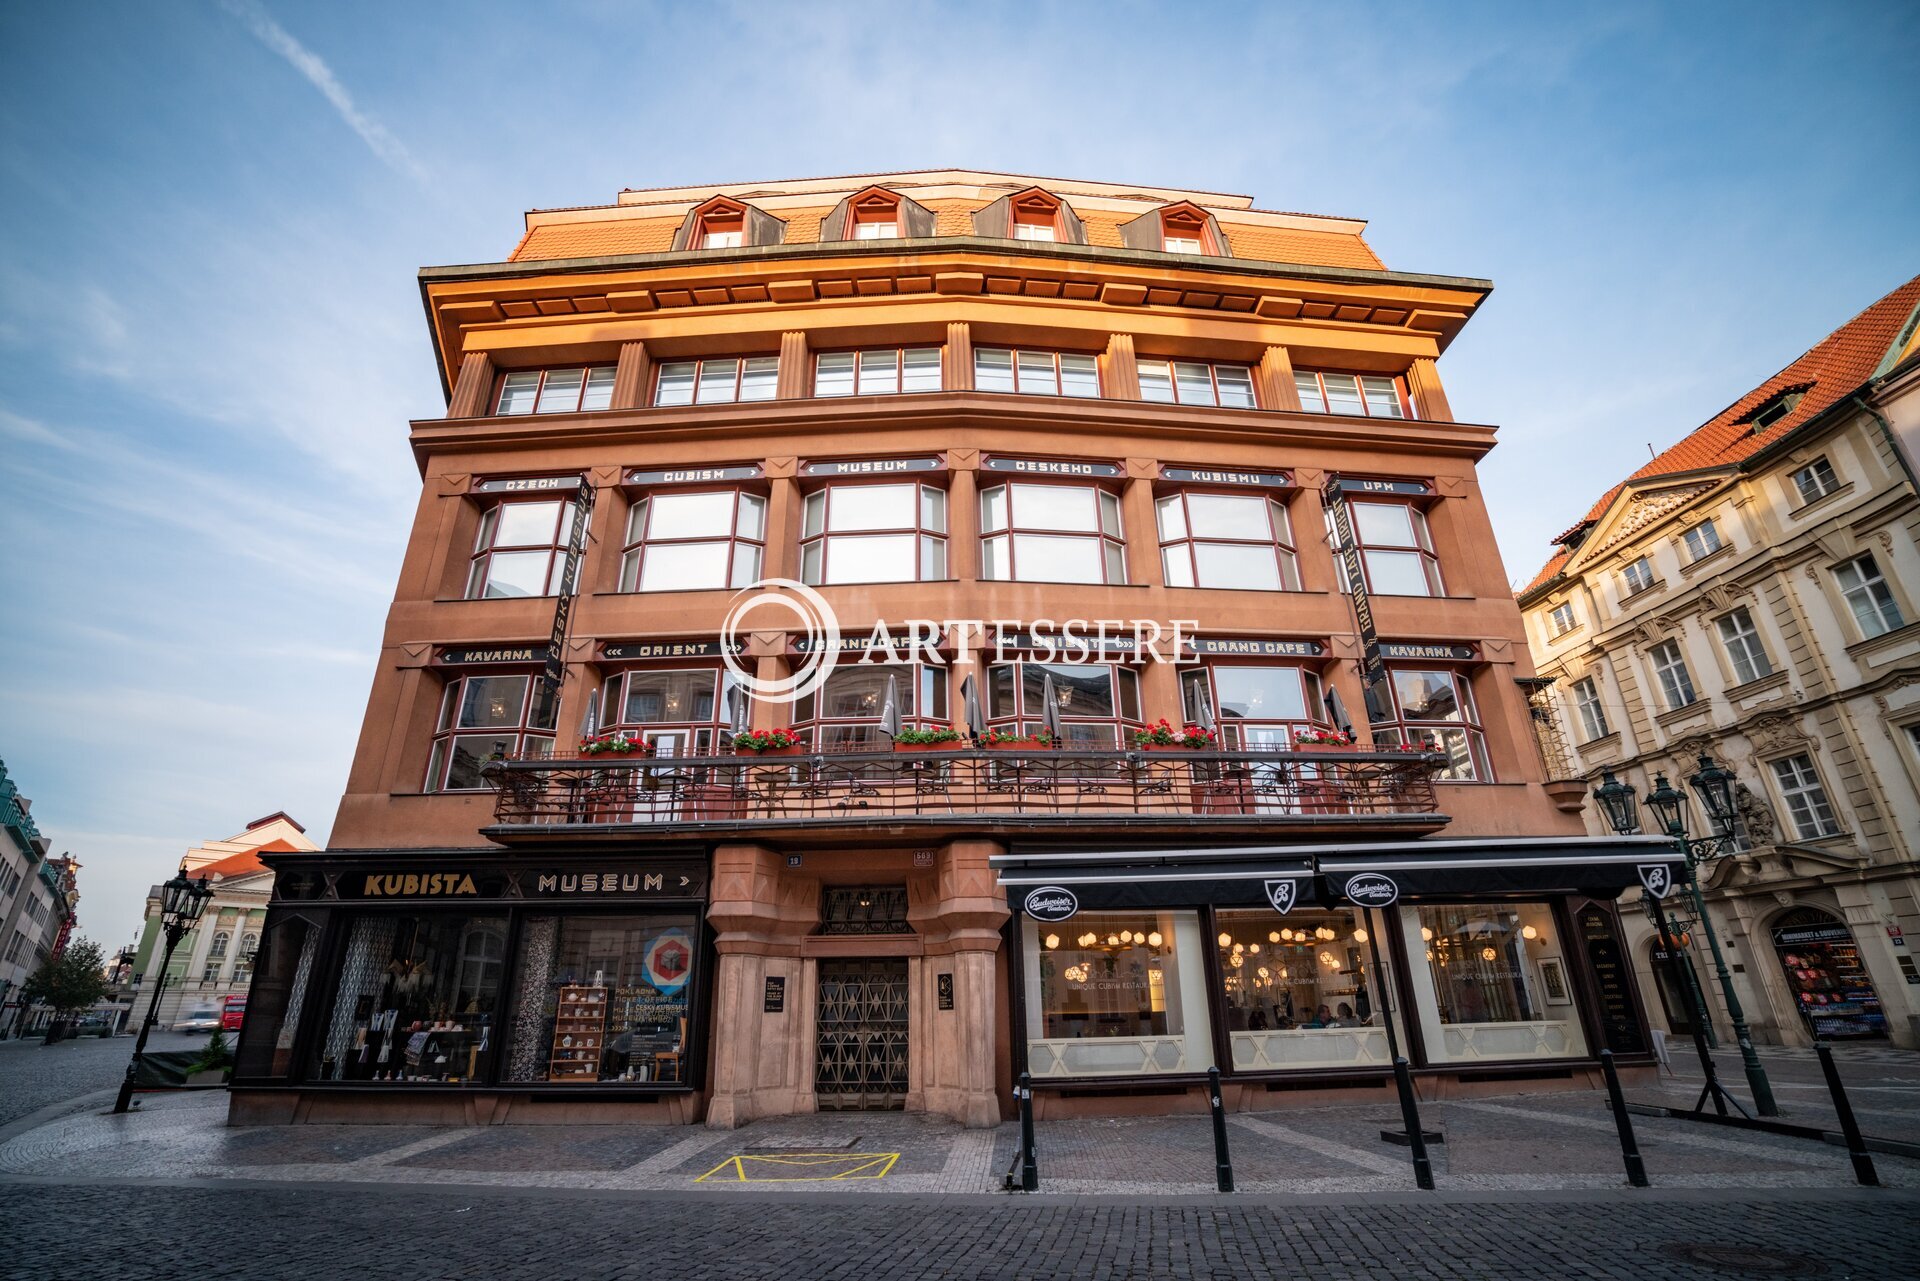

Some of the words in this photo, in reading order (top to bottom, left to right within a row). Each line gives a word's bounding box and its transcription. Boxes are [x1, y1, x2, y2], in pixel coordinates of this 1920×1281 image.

[837, 461, 908, 473] MUSEUM
[663, 470, 725, 482] CUBISM
[1191, 470, 1261, 484] KUBISMU
[505, 479, 559, 490] CZECH
[1362, 481, 1394, 492] UPM
[1332, 496, 1351, 544] ORIENT
[564, 485, 590, 585] KUBISMUS
[1352, 582, 1371, 633] GRAND
[815, 637, 870, 651] GRAND
[1031, 636, 1100, 649] ORIENT
[1206, 641, 1261, 653] GRAND
[1264, 643, 1305, 655] CAFE
[639, 644, 708, 657] ORIENT
[790, 857, 799, 865] 19
[363, 873, 478, 896] KUBISTA
[538, 873, 663, 893] MUSEUM
[1350, 883, 1393, 898] Budweiser
[1029, 896, 1073, 911] Budweiser
[1072, 982, 1096, 991] UNIQUE
